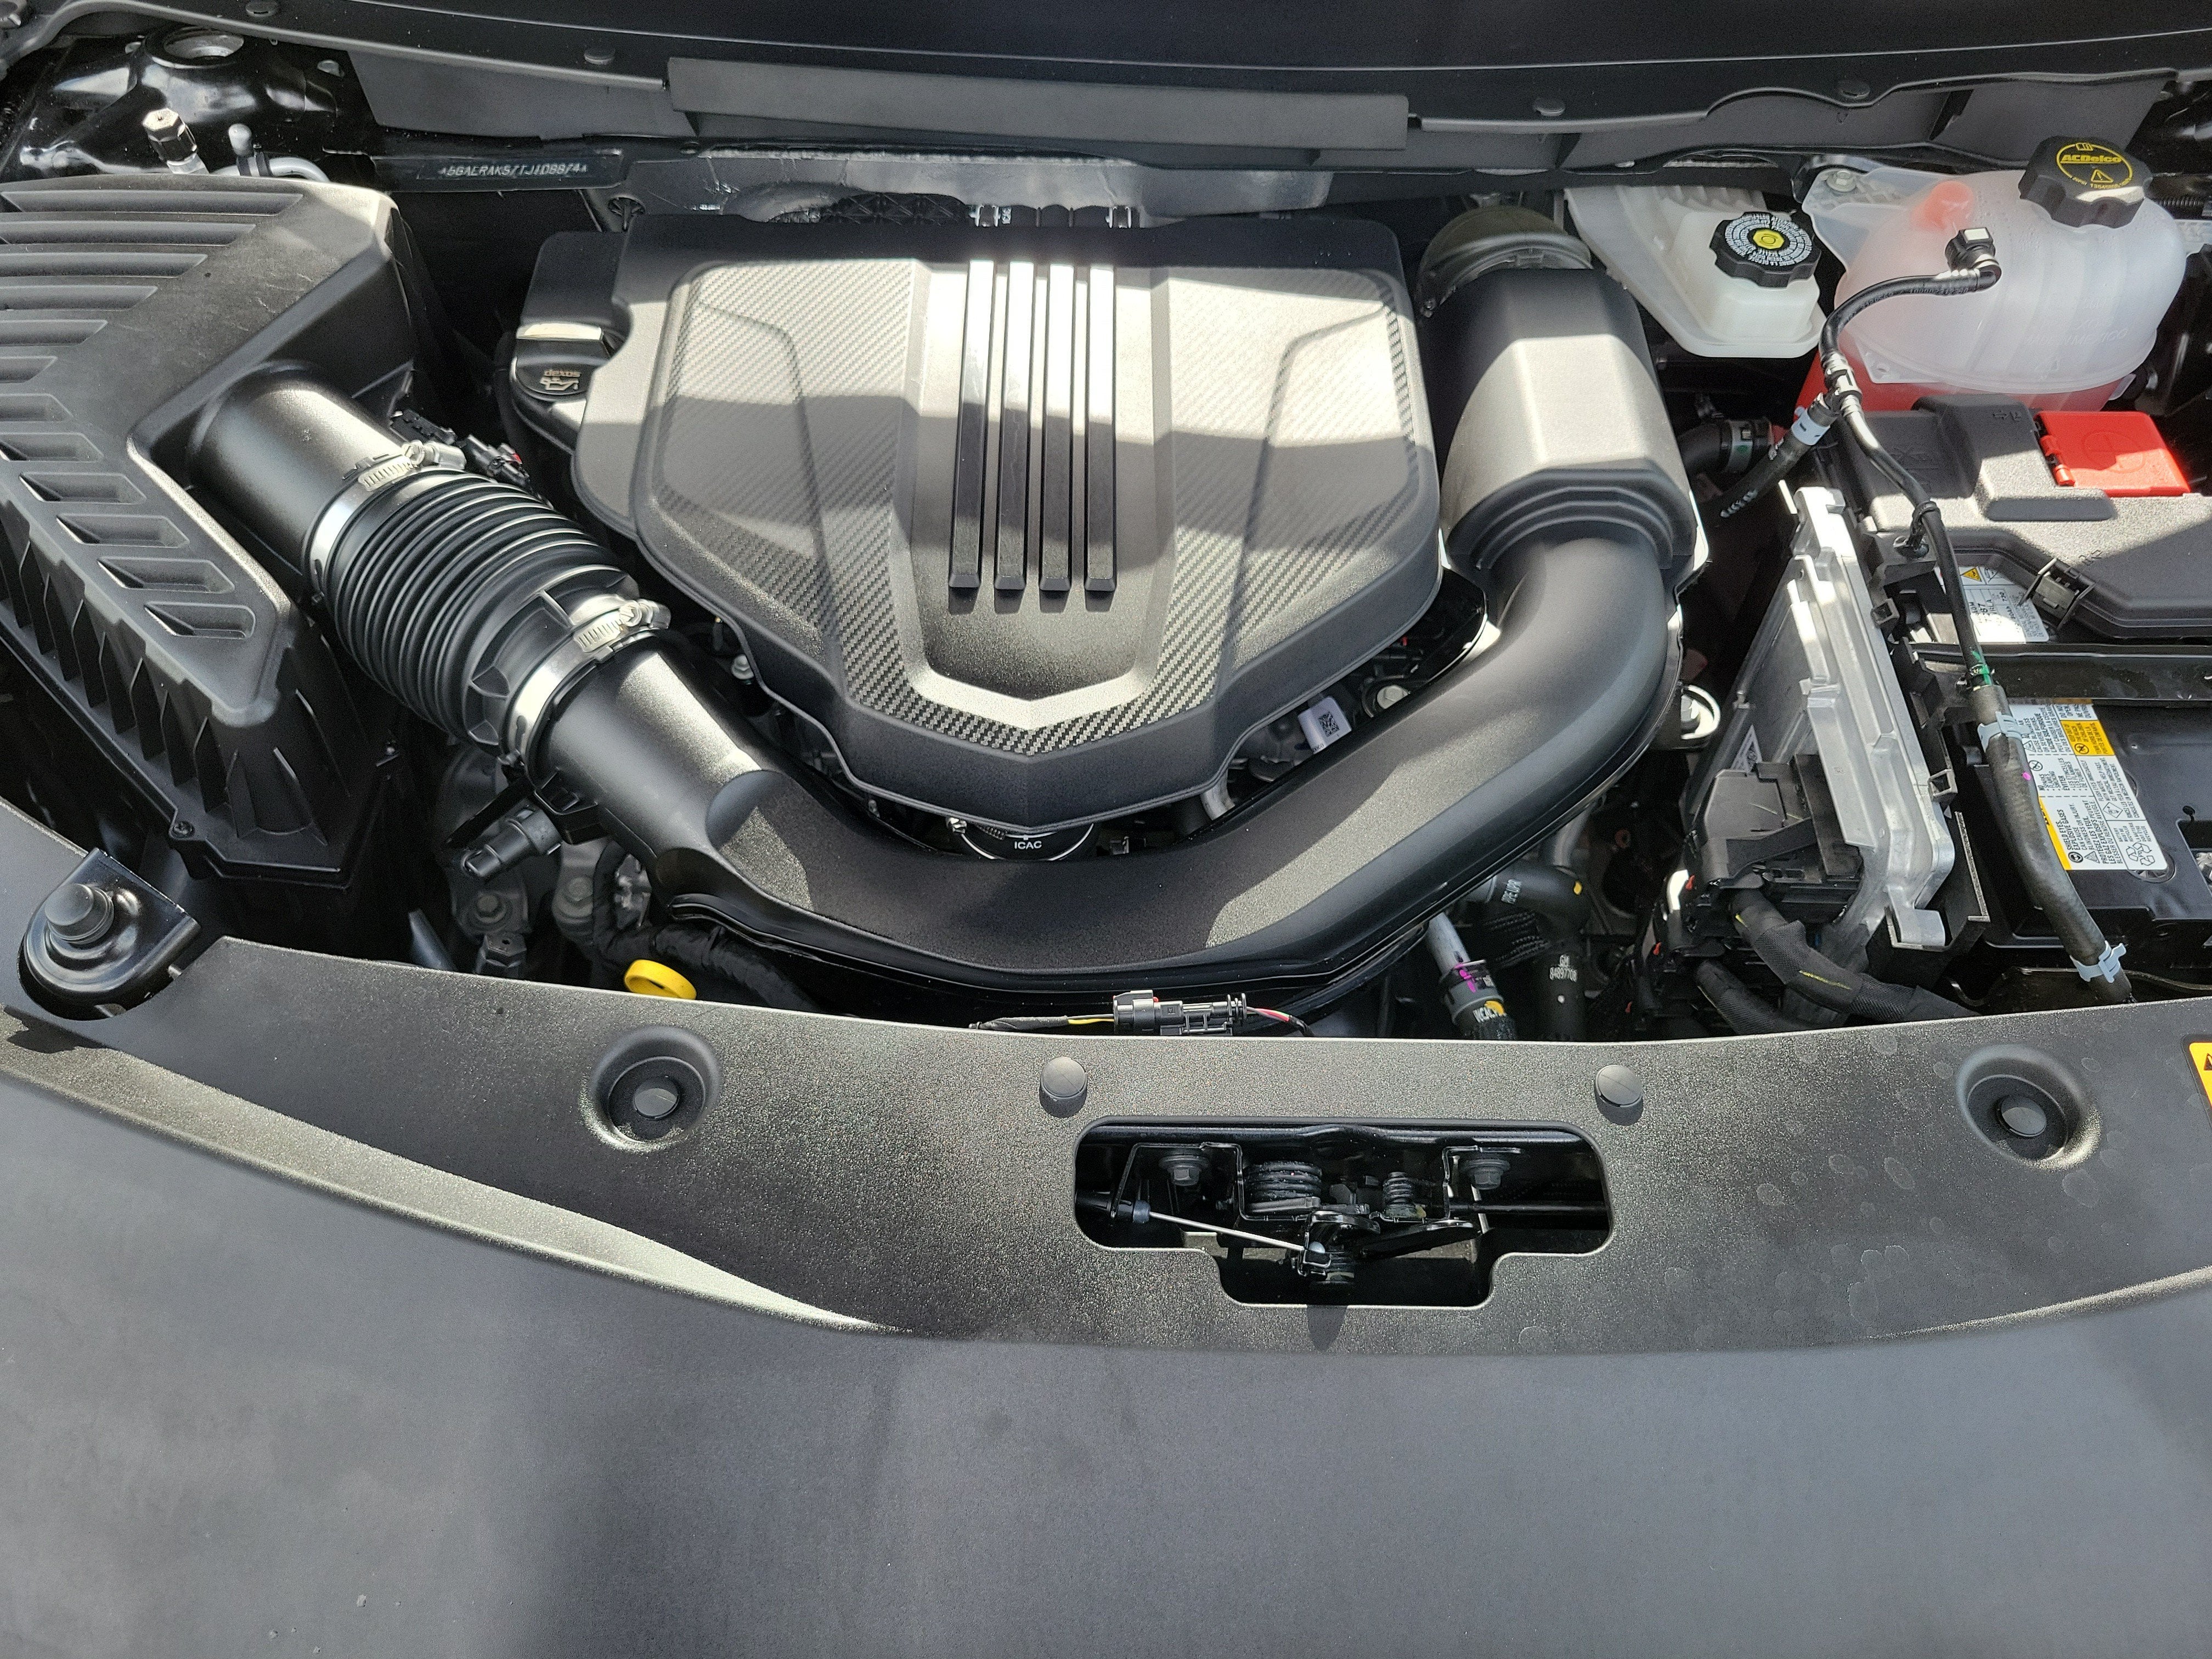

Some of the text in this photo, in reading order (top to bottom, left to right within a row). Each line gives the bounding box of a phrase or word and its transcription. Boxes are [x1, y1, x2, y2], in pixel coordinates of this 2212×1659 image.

[2061, 155, 2122, 163] ACDelco
[544, 369, 581, 377] dexos
[2069, 804, 2080, 819] INJURY.
[2090, 802, 2103, 820] AVEUGLE
[2057, 809, 2081, 850] EXPLOSIVE GASES
[2083, 816, 2093, 829] YEUX.
[2099, 820, 2111, 837] RENDRE
[2056, 820, 2073, 850] SHIELD EYES.
[2073, 827, 2087, 850] CAN CAUSE
[2080, 827, 2095, 850] BLINDNESS
[2082, 800, 2116, 864] LES GAZ EXPLOSIFS PEUVENT
[2089, 831, 2098, 839] LES
[1014, 840, 1042, 849] ICAC
[2110, 845, 2123, 864] BLESSER
